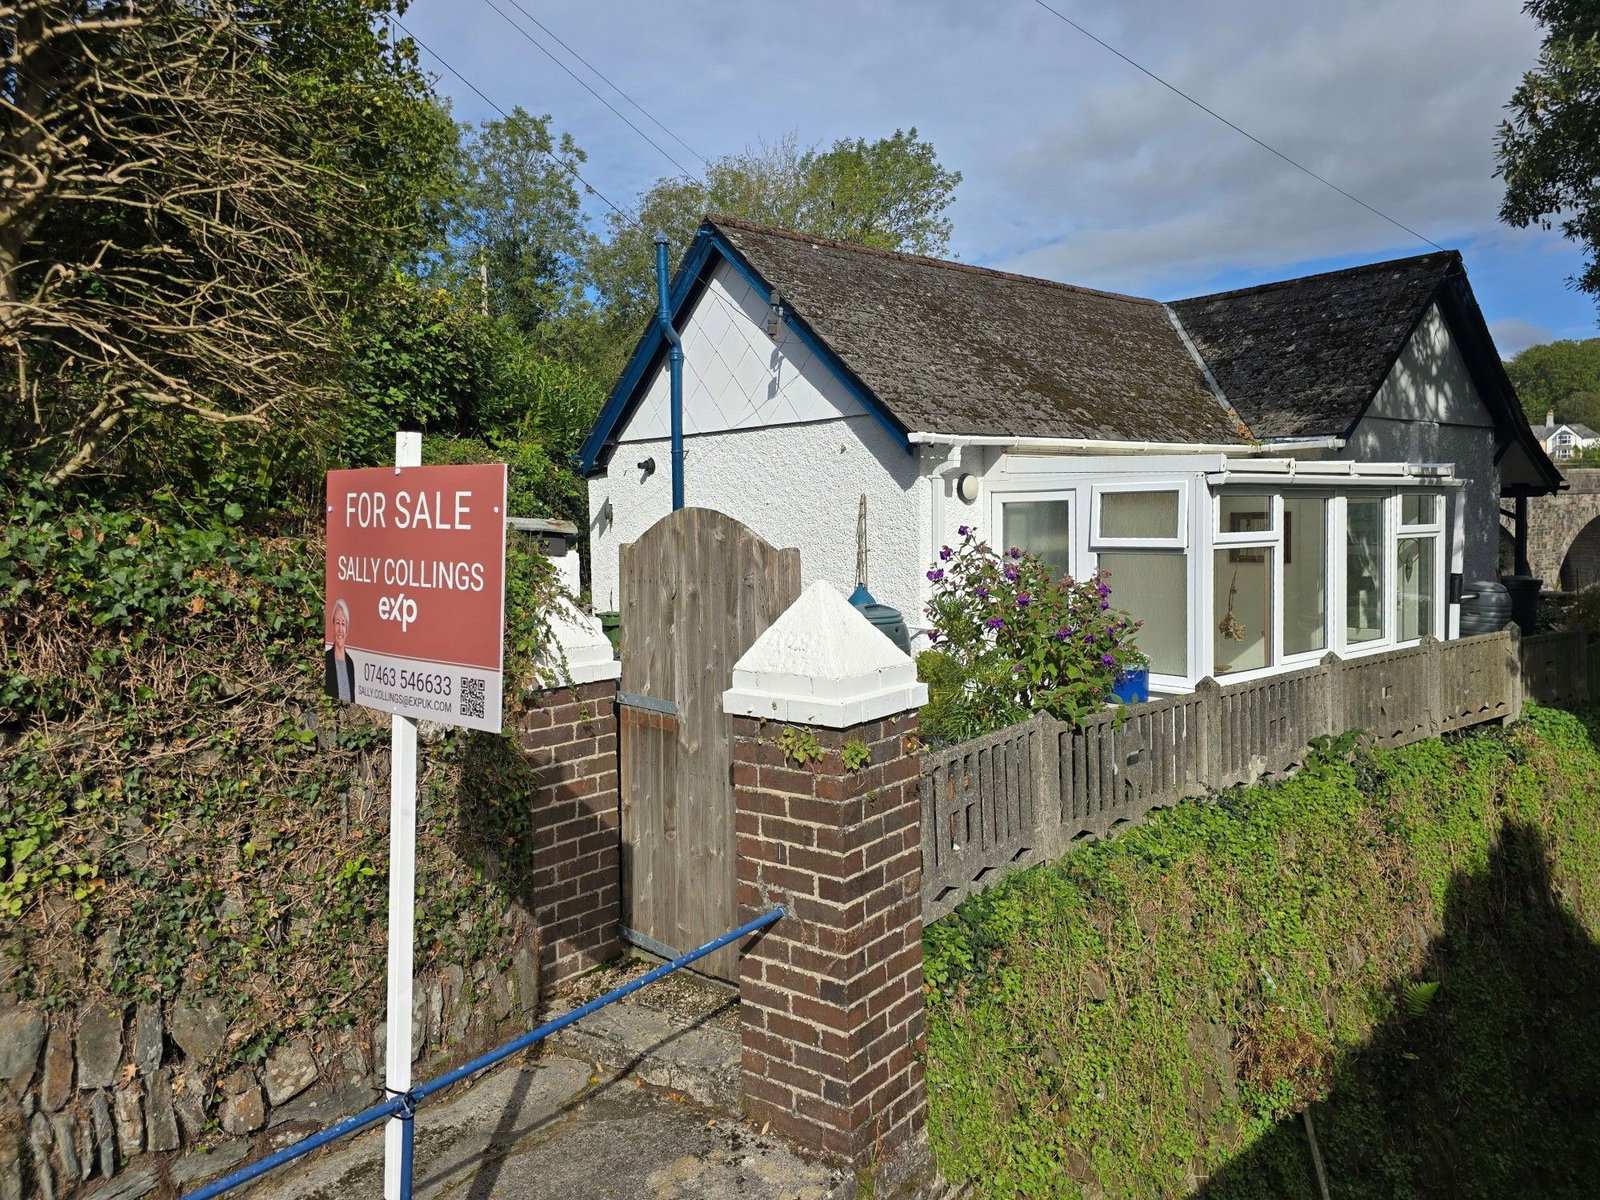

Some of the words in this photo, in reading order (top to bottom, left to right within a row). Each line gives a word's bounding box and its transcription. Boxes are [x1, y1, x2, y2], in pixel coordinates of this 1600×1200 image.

[346, 492, 386, 528] FOR
[394, 490, 472, 530] SALE
[338, 555, 380, 584] SALLY
[384, 558, 484, 592] COLLINGS
[364, 662, 396, 687] 07463
[399, 670, 452, 696] 546633
[357, 684, 452, 713] SALLY.COLLINGS@EXPUK.COM
